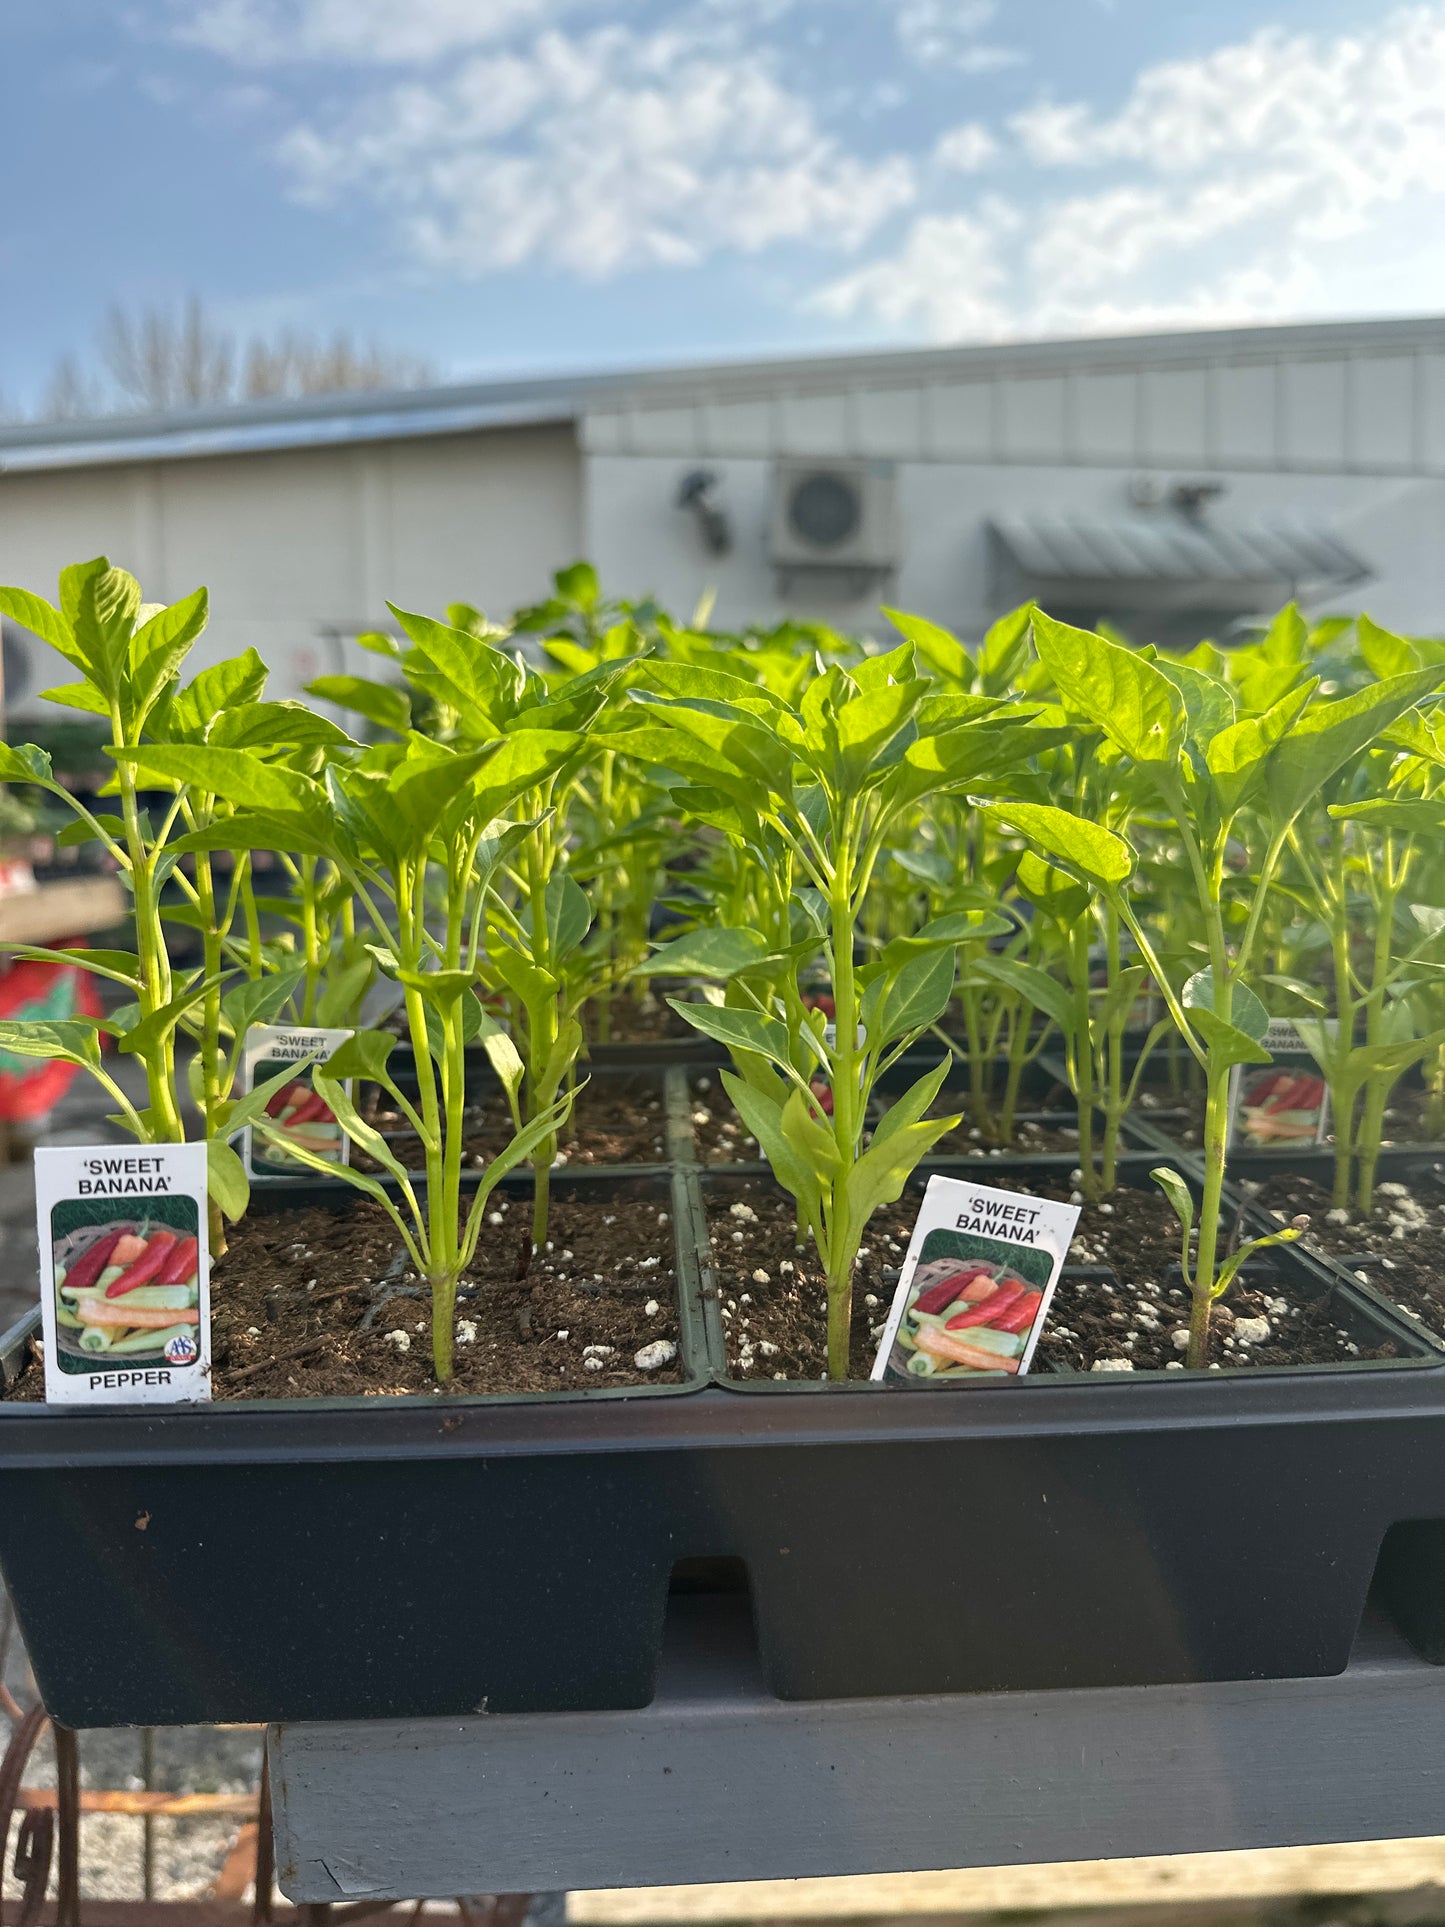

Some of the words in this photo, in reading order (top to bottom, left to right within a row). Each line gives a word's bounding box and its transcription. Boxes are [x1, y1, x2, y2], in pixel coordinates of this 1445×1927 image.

[276, 1034, 327, 1047] 'SWEET
[84, 1157, 165, 1175] 'SWEET
[78, 1176, 172, 1195] BANANA'
[968, 1197, 1040, 1225] 'SWEET
[955, 1214, 1040, 1243] BANANA'
[89, 1371, 171, 1390] PEPPER
